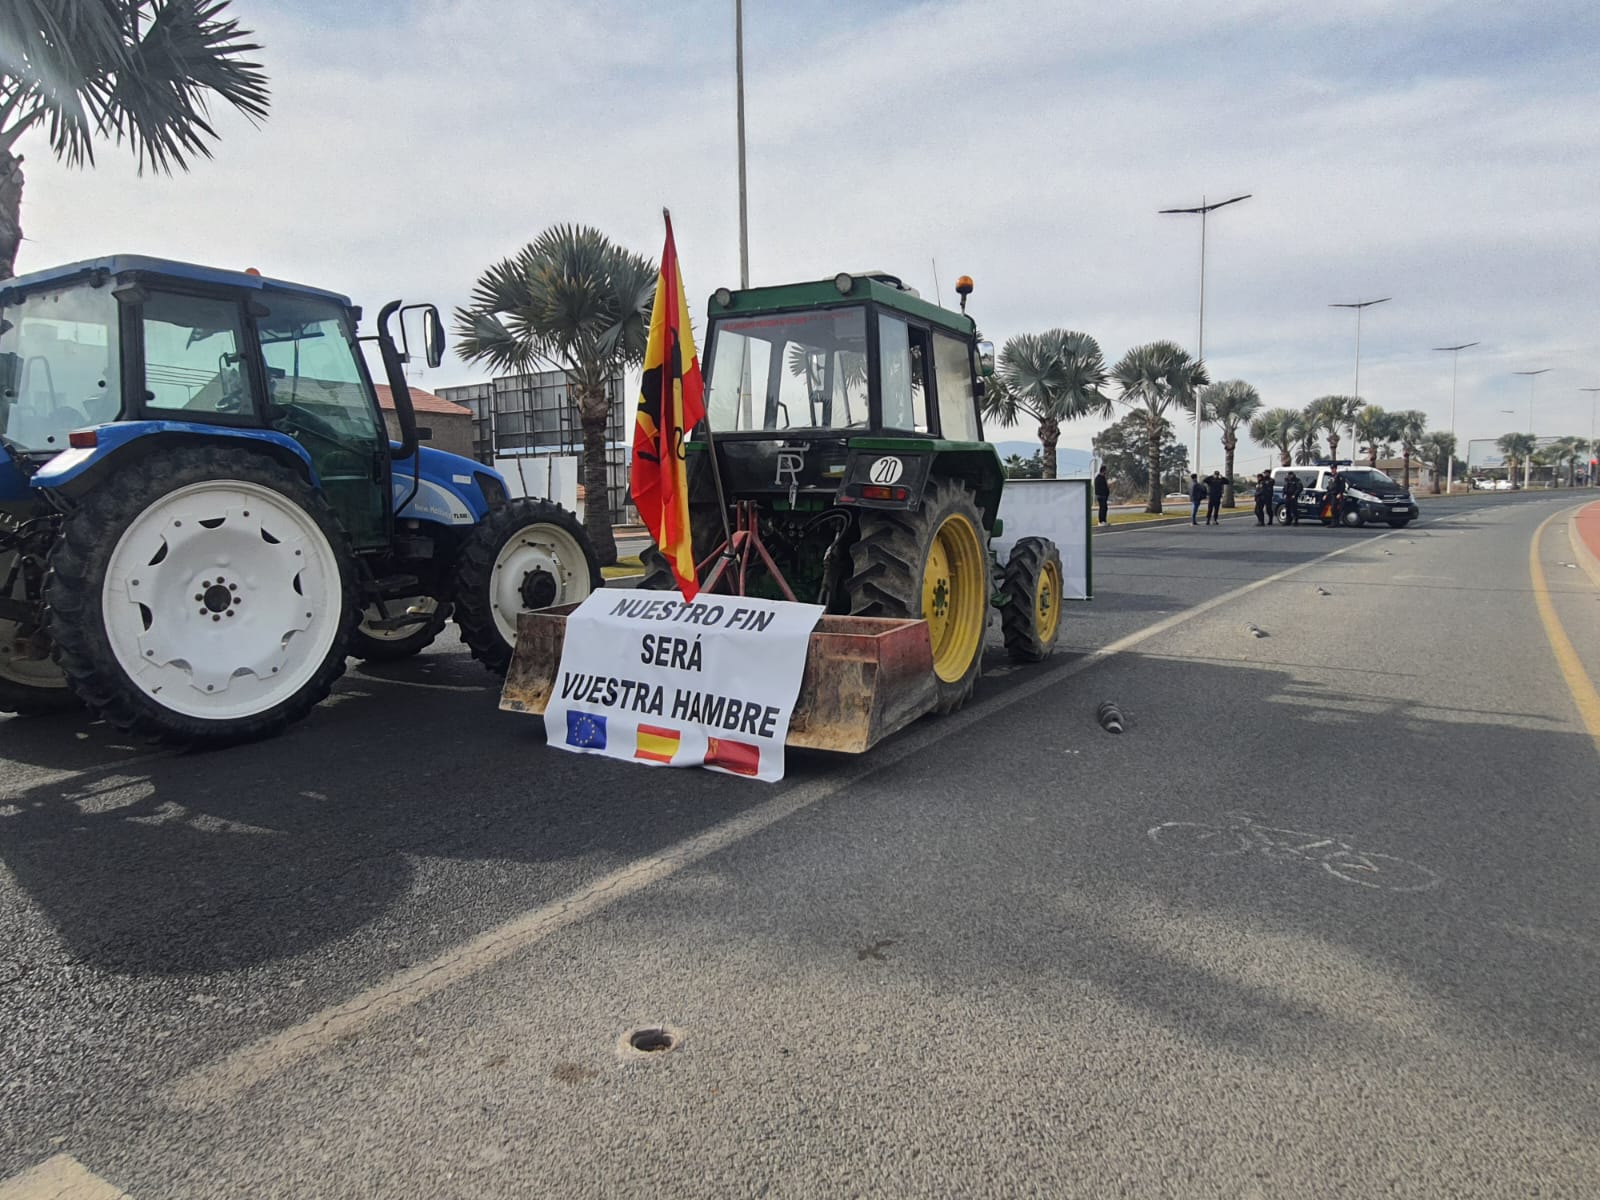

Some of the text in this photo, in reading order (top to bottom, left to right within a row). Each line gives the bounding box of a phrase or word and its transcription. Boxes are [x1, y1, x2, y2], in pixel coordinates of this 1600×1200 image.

[874, 459, 898, 484] 20
[609, 598, 775, 632] NUESTRO FIN
[640, 633, 703, 673] SERÁ
[560, 671, 781, 739] VUESTRA HAMBRE
